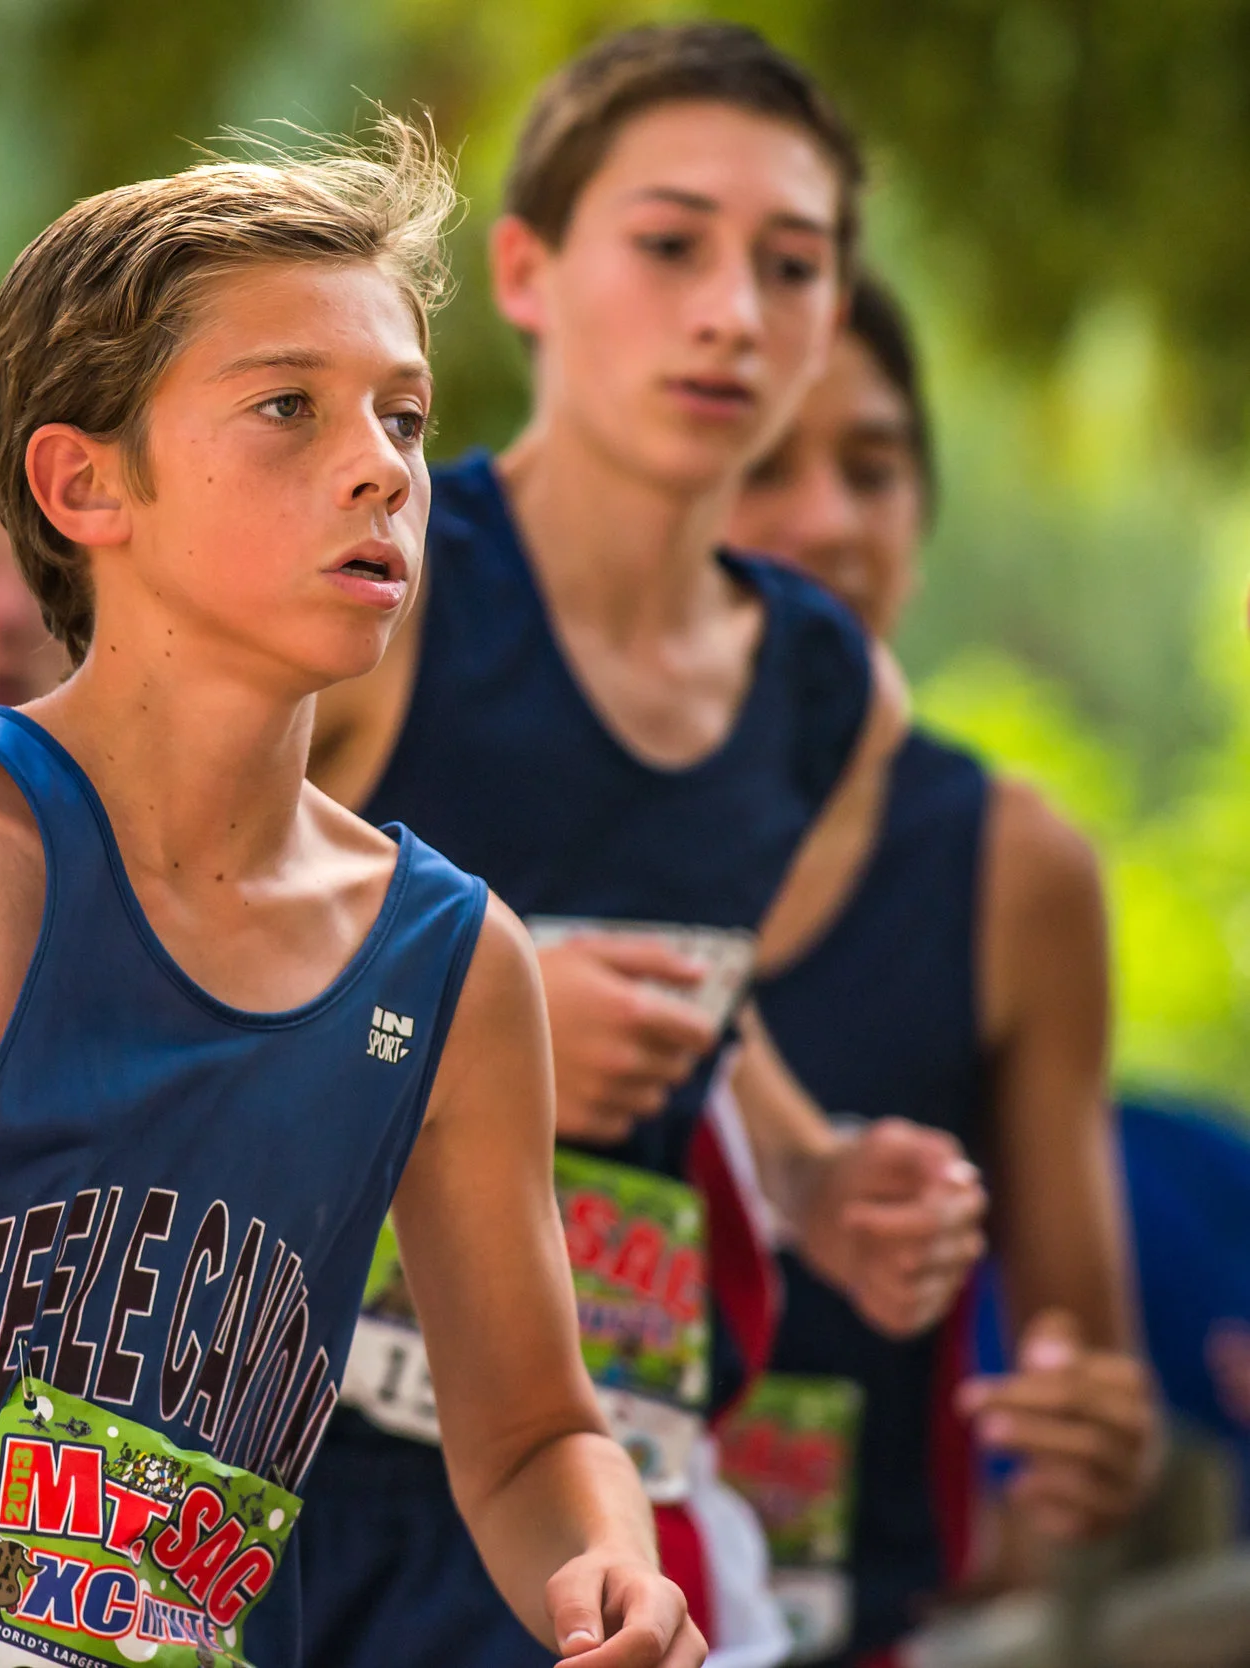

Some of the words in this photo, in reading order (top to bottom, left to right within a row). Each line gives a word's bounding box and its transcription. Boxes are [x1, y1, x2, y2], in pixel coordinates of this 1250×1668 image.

[366, 1028, 403, 1063] SPORT
[371, 1005, 414, 1038] IN
[5, 1446, 34, 1523] 2013
[17, 1549, 138, 1634] XC
[152, 1486, 275, 1628] SAC
